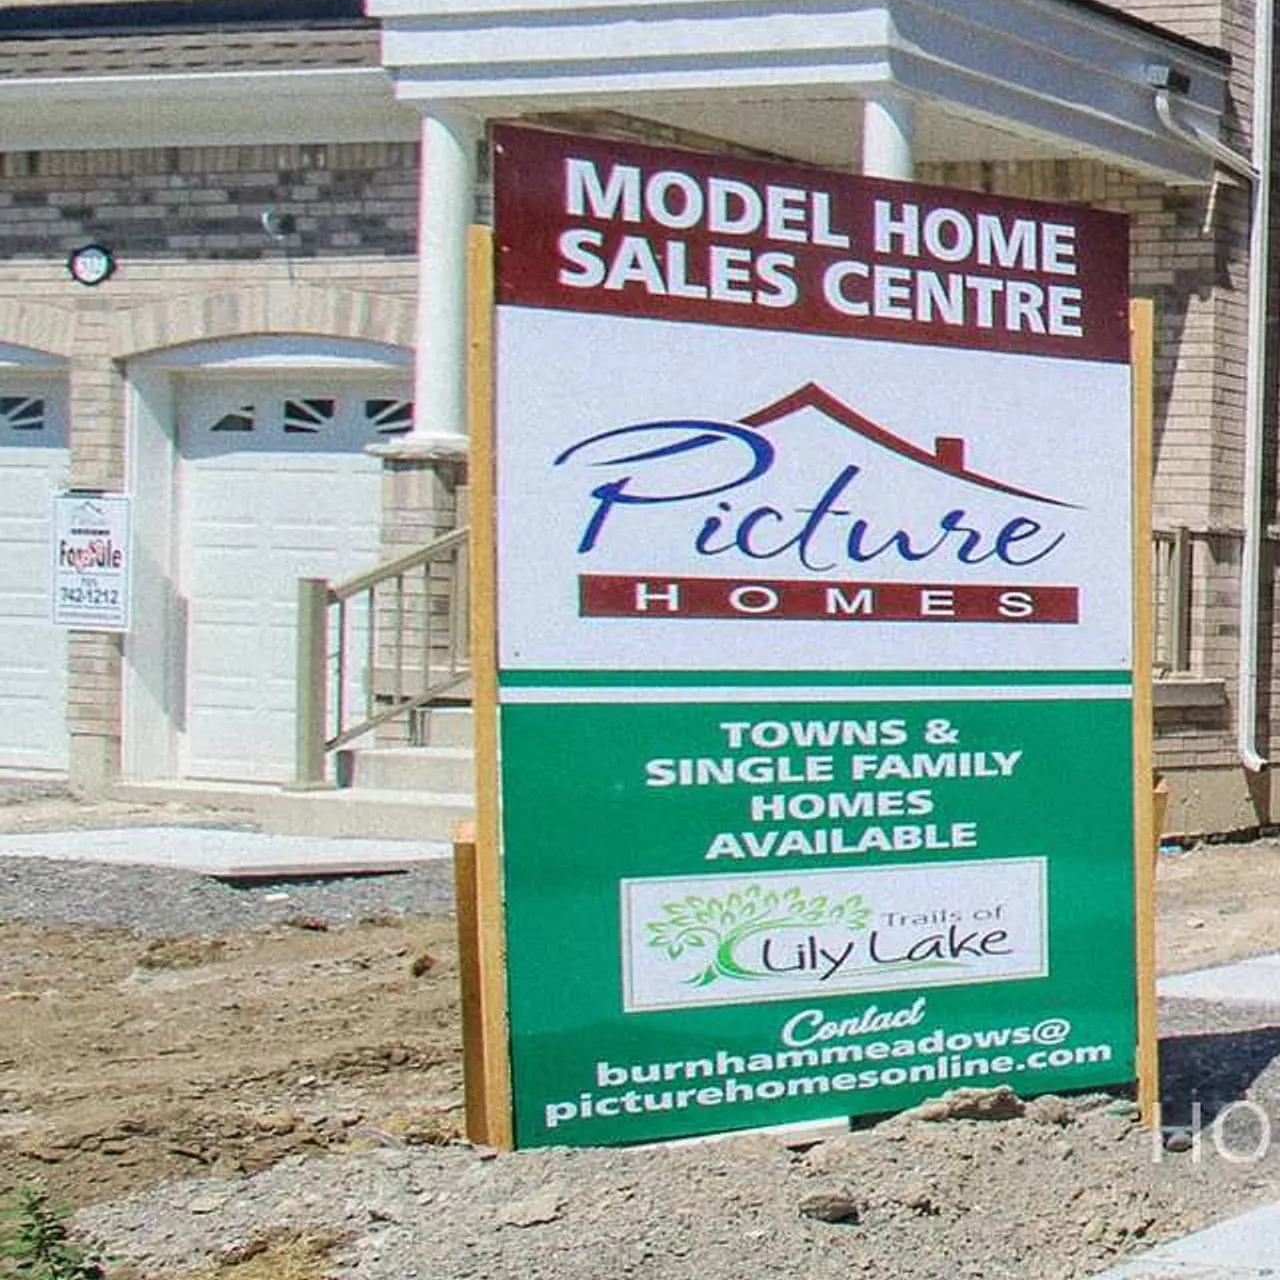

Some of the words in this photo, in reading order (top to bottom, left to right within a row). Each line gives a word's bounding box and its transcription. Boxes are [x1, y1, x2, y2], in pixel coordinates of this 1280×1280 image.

[565, 157, 849, 248] MODEL
[874, 200, 1077, 276] HOME
[558, 228, 799, 308] SALES
[823, 260, 1083, 337] CENTRE
[554, 419, 1066, 572] Picture
[635, 582, 1035, 619] HOMES
[719, 719, 908, 749] TOWNS
[924, 718, 960, 746] &
[645, 756, 834, 787] SINGLE
[852, 750, 1024, 781] FAMILY
[750, 790, 934, 822] HOMES
[704, 822, 978, 861] AVAILABLE
[882, 908, 962, 927] Trails
[972, 900, 1003, 920] of
[763, 935, 854, 981] Lily
[869, 924, 1013, 963] Lake
[782, 996, 927, 1048] Contact
[596, 1018, 1072, 1088] burnhammeadows@
[544, 1042, 1112, 1127] picturehomesonline.com
